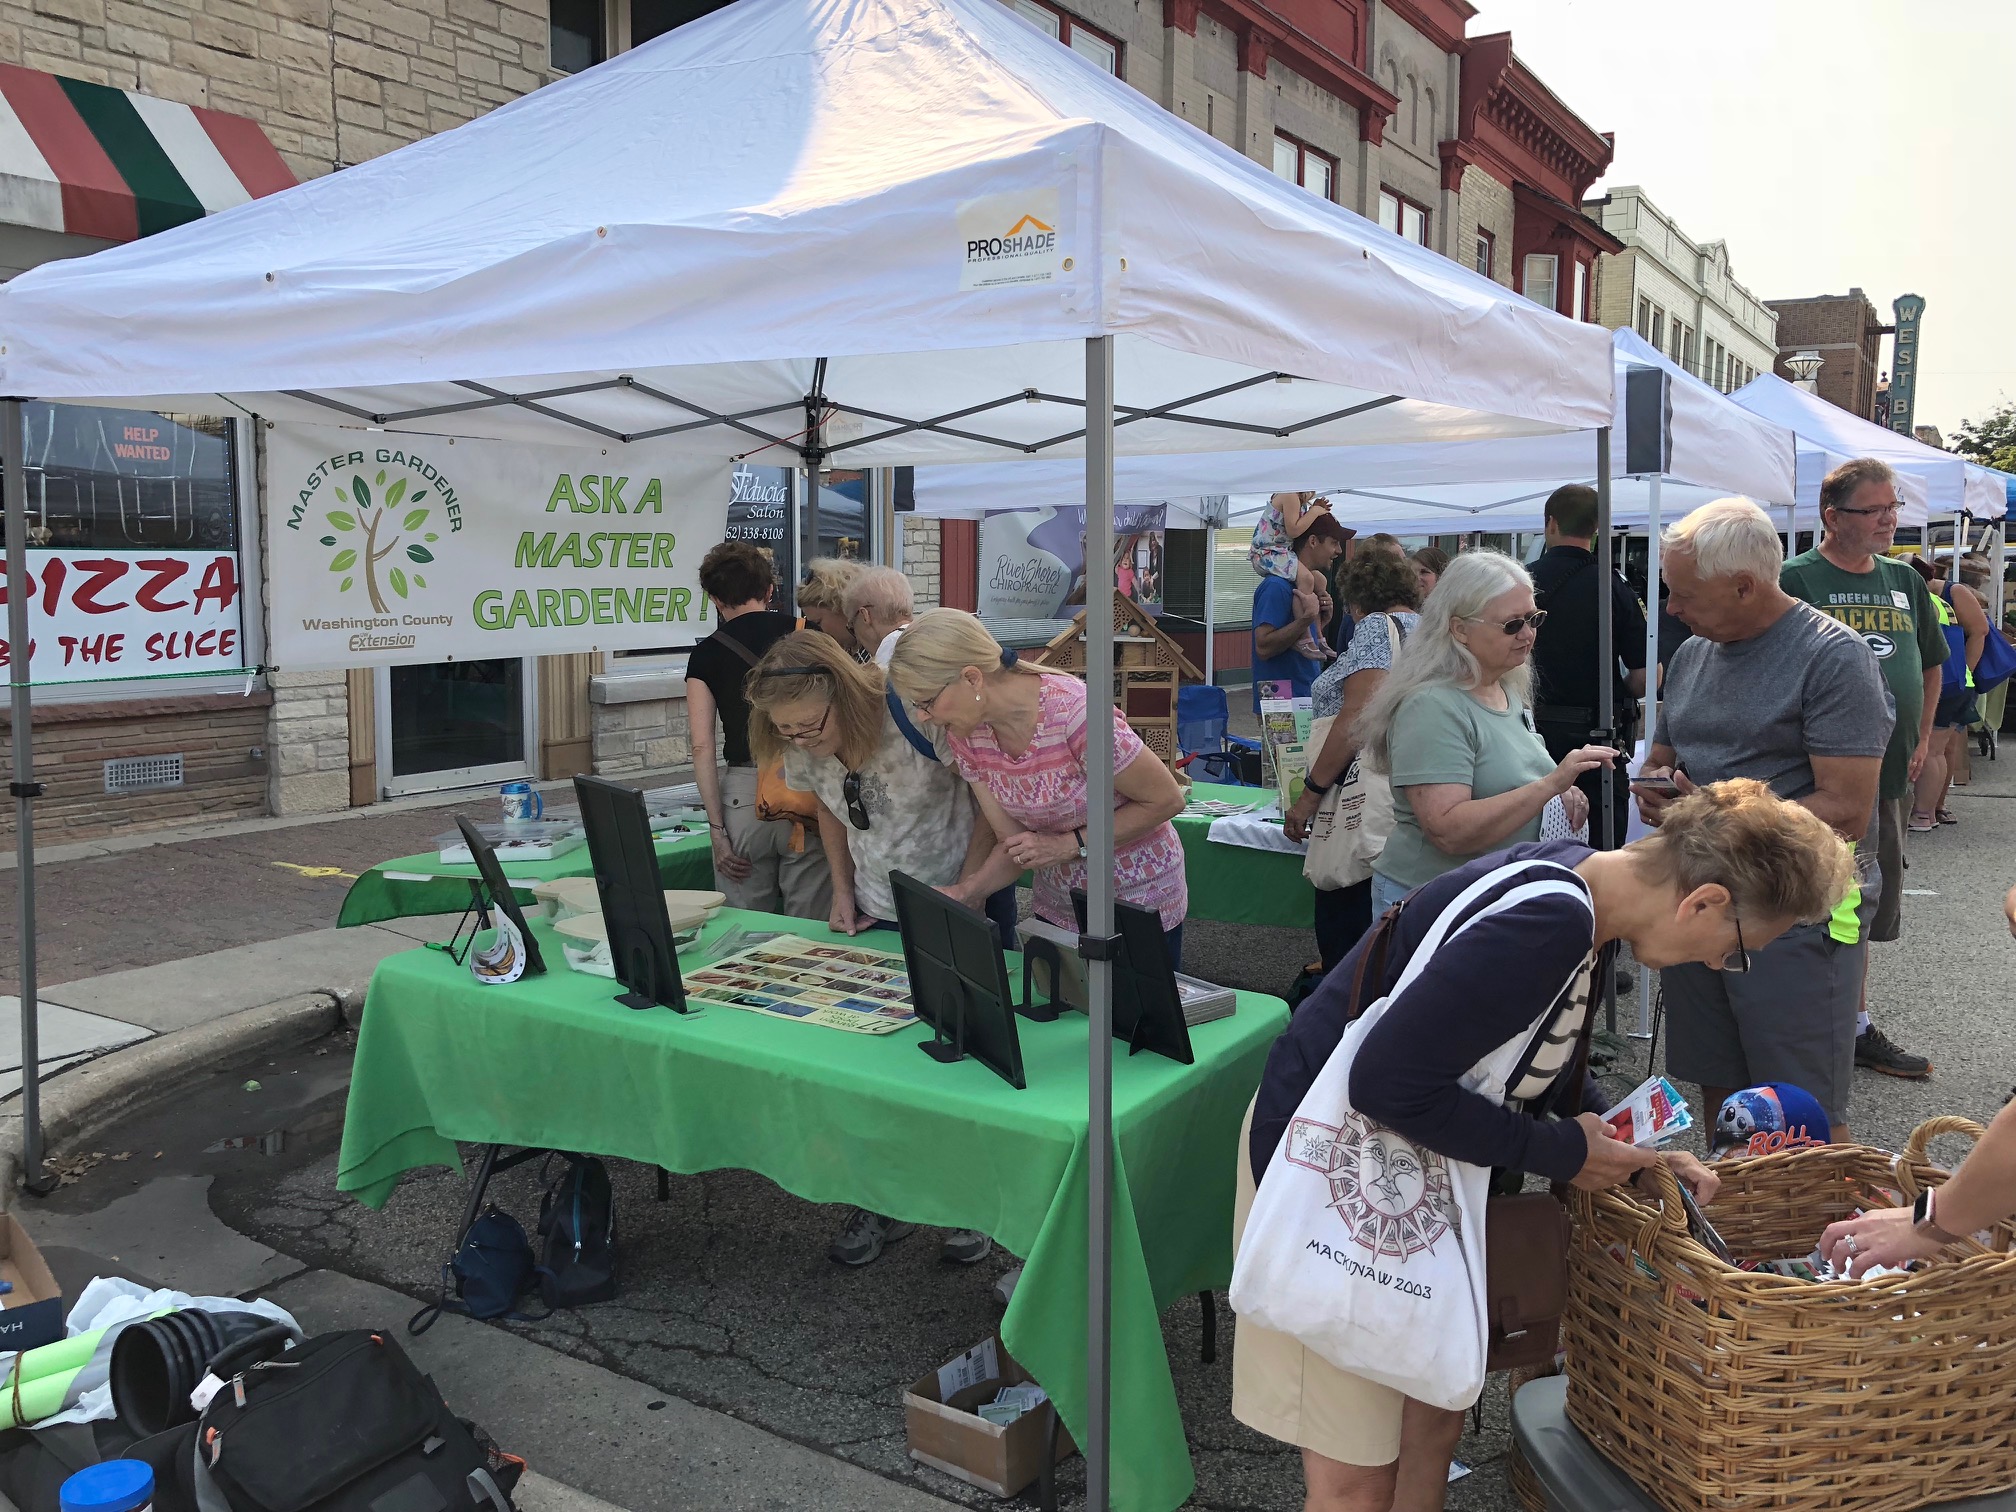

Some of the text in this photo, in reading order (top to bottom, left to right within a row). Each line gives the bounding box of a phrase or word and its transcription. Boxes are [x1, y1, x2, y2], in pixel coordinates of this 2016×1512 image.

[967, 232, 1056, 259] PROSHADE
[967, 248, 1054, 263] PROFESSIONAL QUALITY
[1897, 305, 1917, 388] WEST
[123, 426, 159, 443] HELP
[114, 443, 171, 460] WANTED
[286, 449, 463, 533] MASTER GARDENER
[545, 474, 663, 514] ASK A
[746, 504, 785, 520] Salon
[742, 525, 784, 541] 338-8108
[514, 531, 676, 569] MASTER
[989, 577, 1059, 595] CHIROPRACTIC
[1828, 592, 1870, 604] GREEN
[302, 614, 453, 631] Washington County
[58, 633, 125, 667] THE
[145, 628, 237, 662] SLICE
[349, 632, 416, 651] Extension
[1746, 1124, 1812, 1157] ROLL
[1305, 1239, 1433, 1300] MACKINAW 2003
